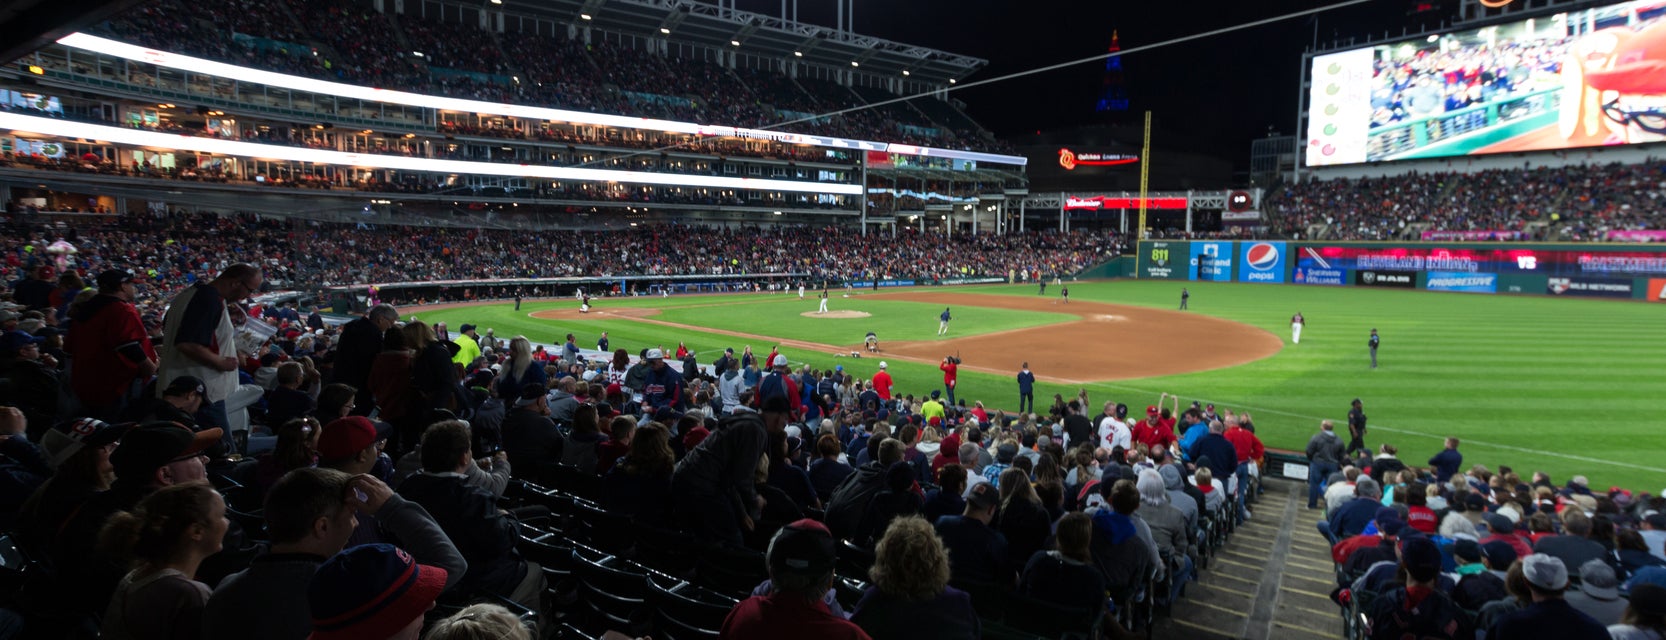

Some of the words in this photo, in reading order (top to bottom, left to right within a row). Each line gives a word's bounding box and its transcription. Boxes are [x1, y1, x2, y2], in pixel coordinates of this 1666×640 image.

[1151, 249, 1169, 261] 811
[1517, 255, 1537, 270] VS
[1248, 271, 1275, 280] pepsi
[1377, 275, 1410, 283] RAM
[1427, 275, 1495, 288] PROGRESSIVE
[1106, 432, 1113, 444] 4
